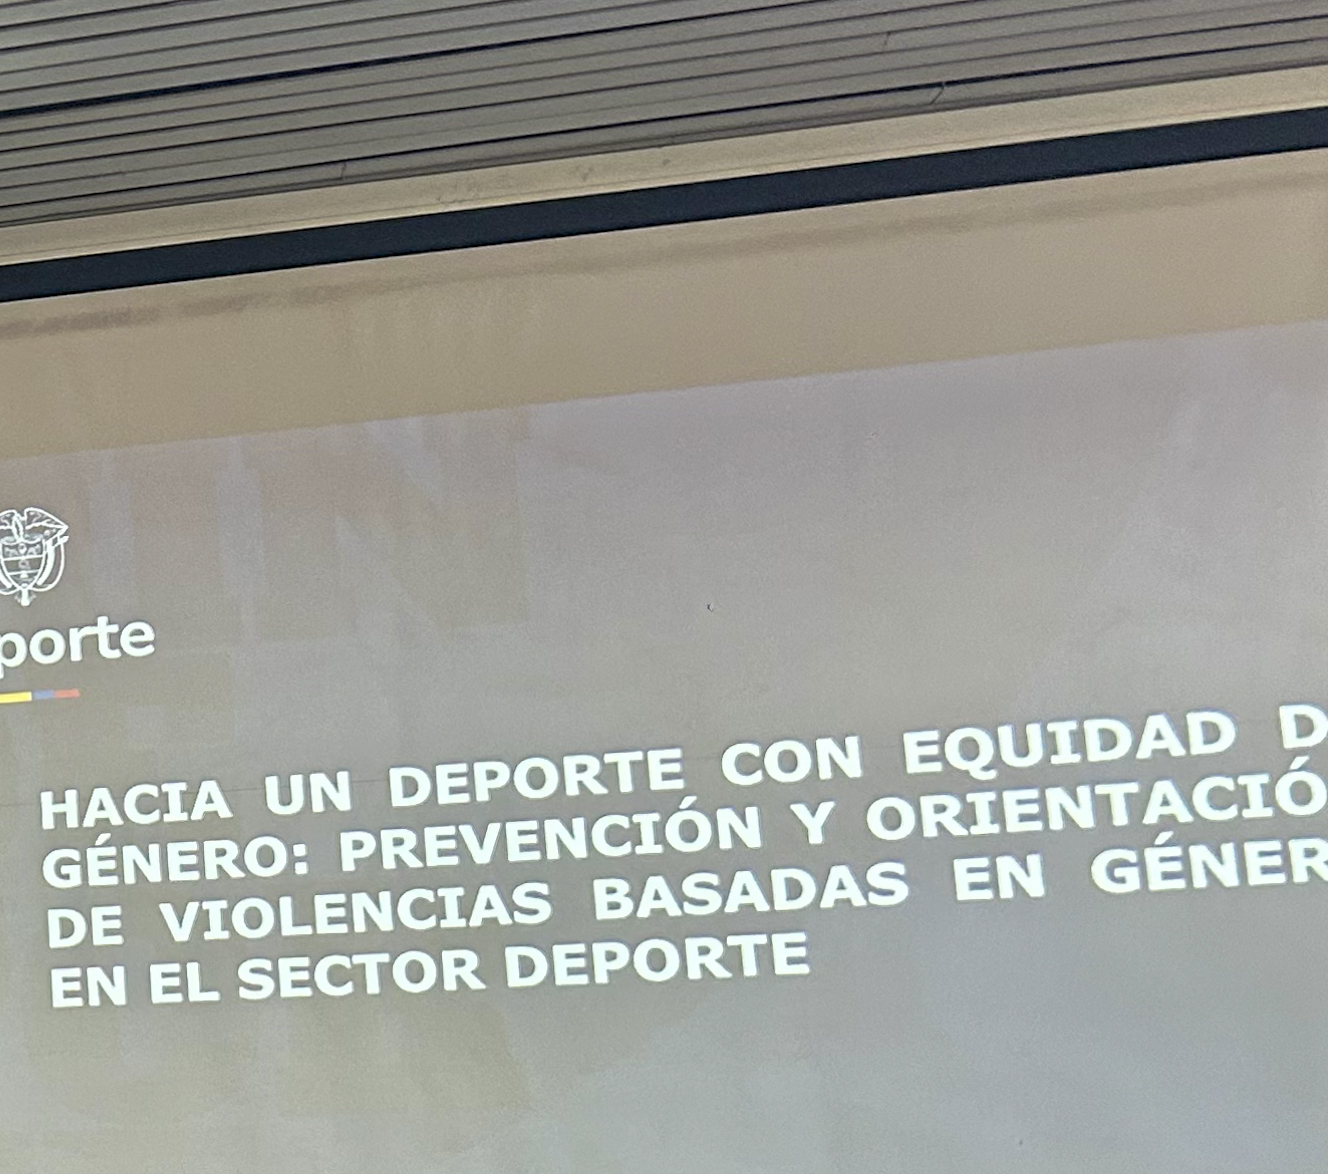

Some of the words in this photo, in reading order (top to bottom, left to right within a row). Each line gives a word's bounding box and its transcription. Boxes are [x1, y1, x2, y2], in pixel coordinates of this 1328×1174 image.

[40, 780, 234, 830] HACIA
[265, 767, 352, 815] UN
[389, 748, 685, 807] DEPORTE
[721, 735, 862, 786] CON
[903, 711, 1237, 781] EQUIDAD
[1279, 704, 1328, 750] D
[42, 832, 309, 889] GÉNERO:
[340, 795, 762, 872] PREVENCIÓN
[789, 801, 835, 845] Y
[866, 755, 1328, 841] ORIENTACIÓ
[47, 905, 124, 949] DE
[158, 882, 552, 942] VIOLENCIAS
[593, 862, 909, 921] BASADAS
[953, 854, 1045, 901] EN
[1090, 830, 1328, 894] GÉNER
[51, 965, 127, 1008] EN
[149, 961, 220, 1004] EL
[237, 942, 487, 1000] SECTOR
[504, 932, 811, 988] DEPORTE
